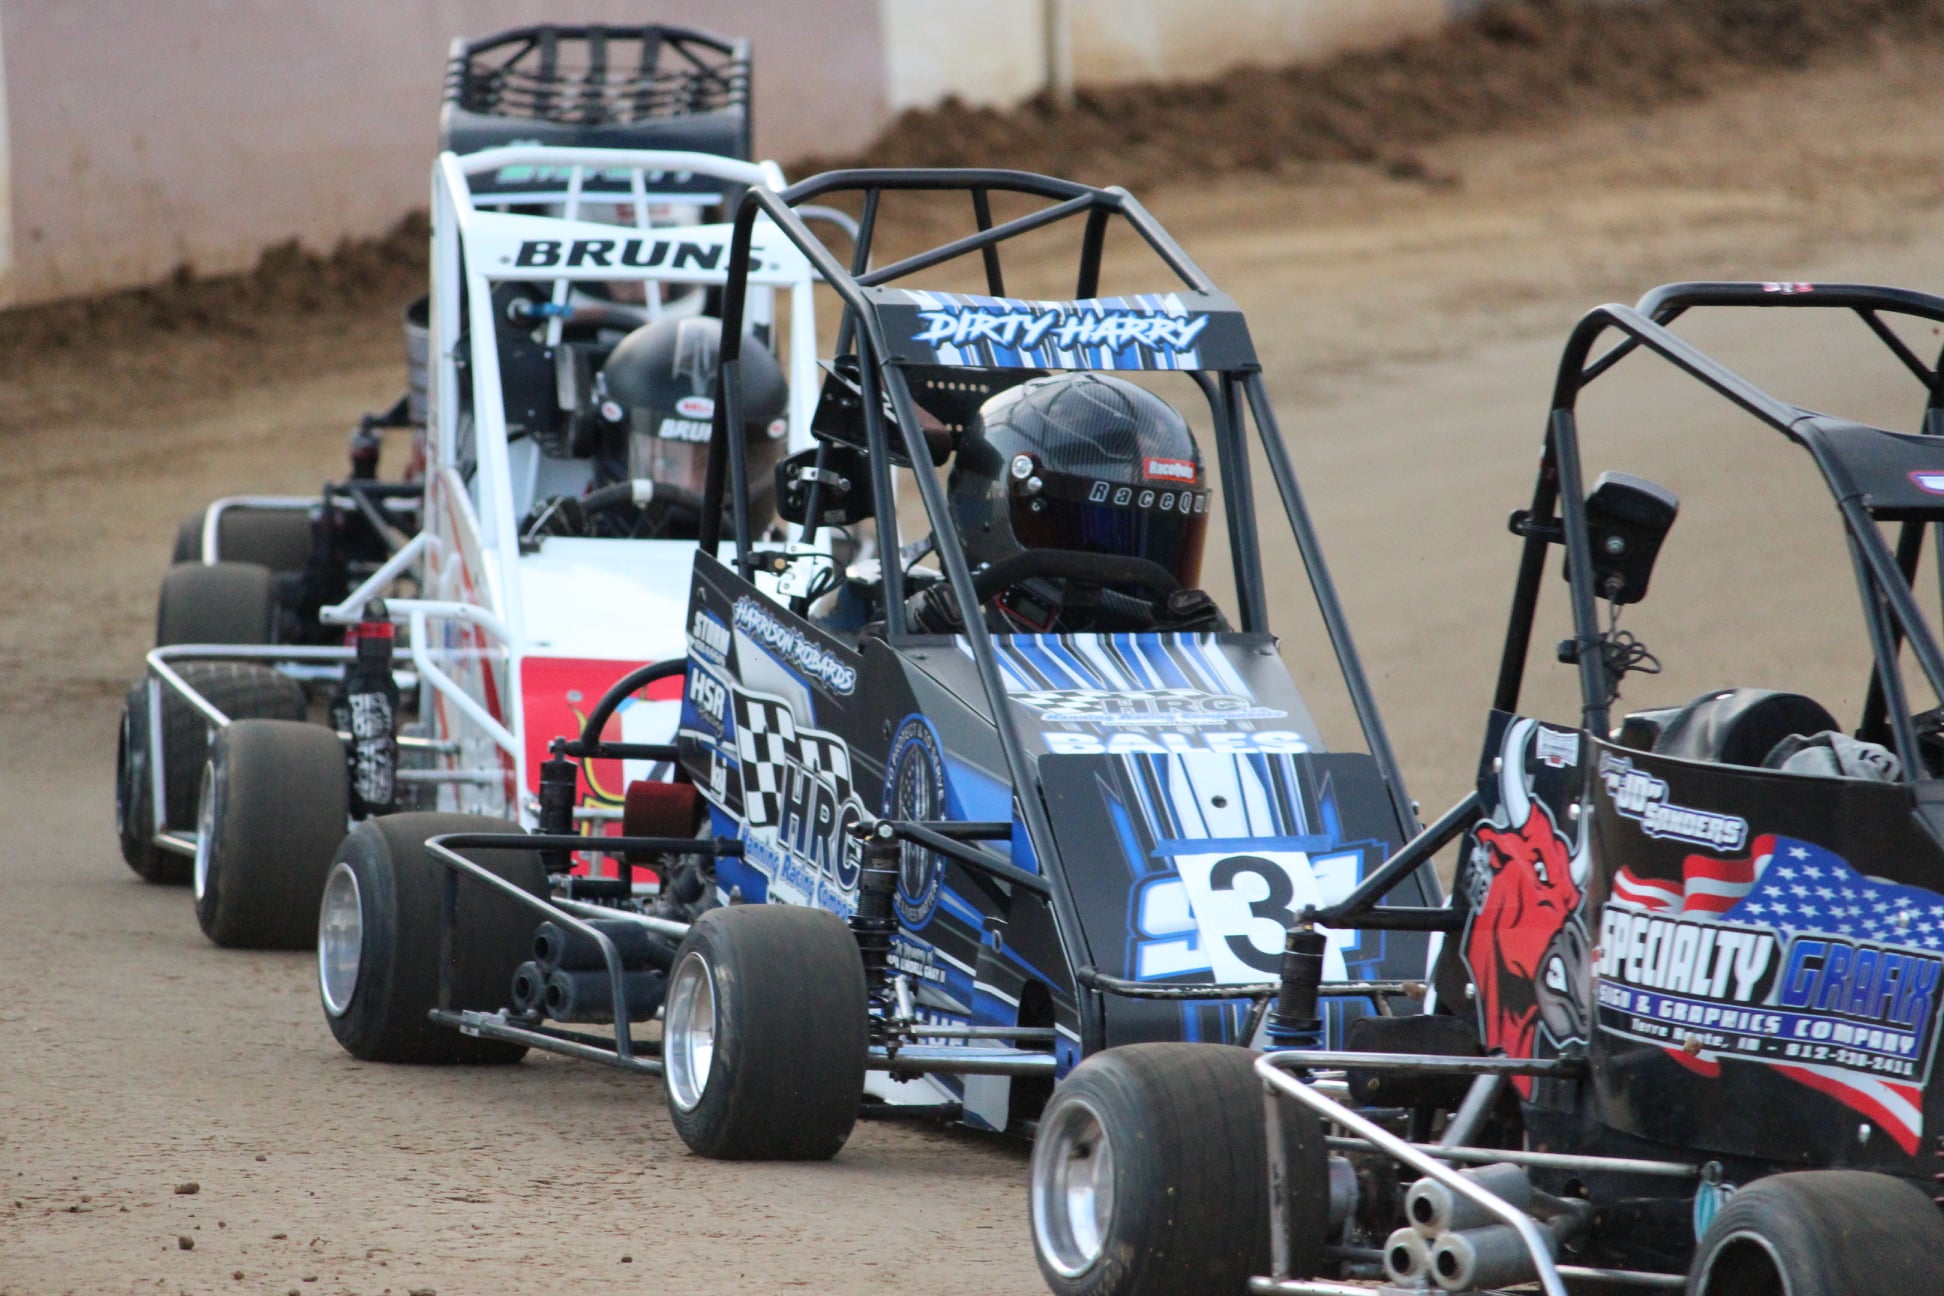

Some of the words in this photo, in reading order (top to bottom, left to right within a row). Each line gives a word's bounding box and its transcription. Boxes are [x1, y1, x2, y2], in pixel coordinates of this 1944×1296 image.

[912, 308, 1058, 349] DIRTY
[1051, 309, 1210, 352] HARRY
[1102, 695, 1249, 713] HRC
[1041, 731, 1310, 753] BALES
[777, 753, 863, 892] HRC
[1643, 801, 1744, 845] SANDERS
[1210, 855, 1294, 975] 3
[1598, 908, 1776, 1002] SPECIALTY
[1781, 940, 1942, 1032] GRAFIX
[1598, 984, 1632, 1009] SIGN
[1635, 995, 1651, 1014] &
[1658, 999, 1783, 1035] GRAPHICS
[1794, 1018, 1916, 1055] COMPANY
[1631, 1017, 1668, 1038] Terre
